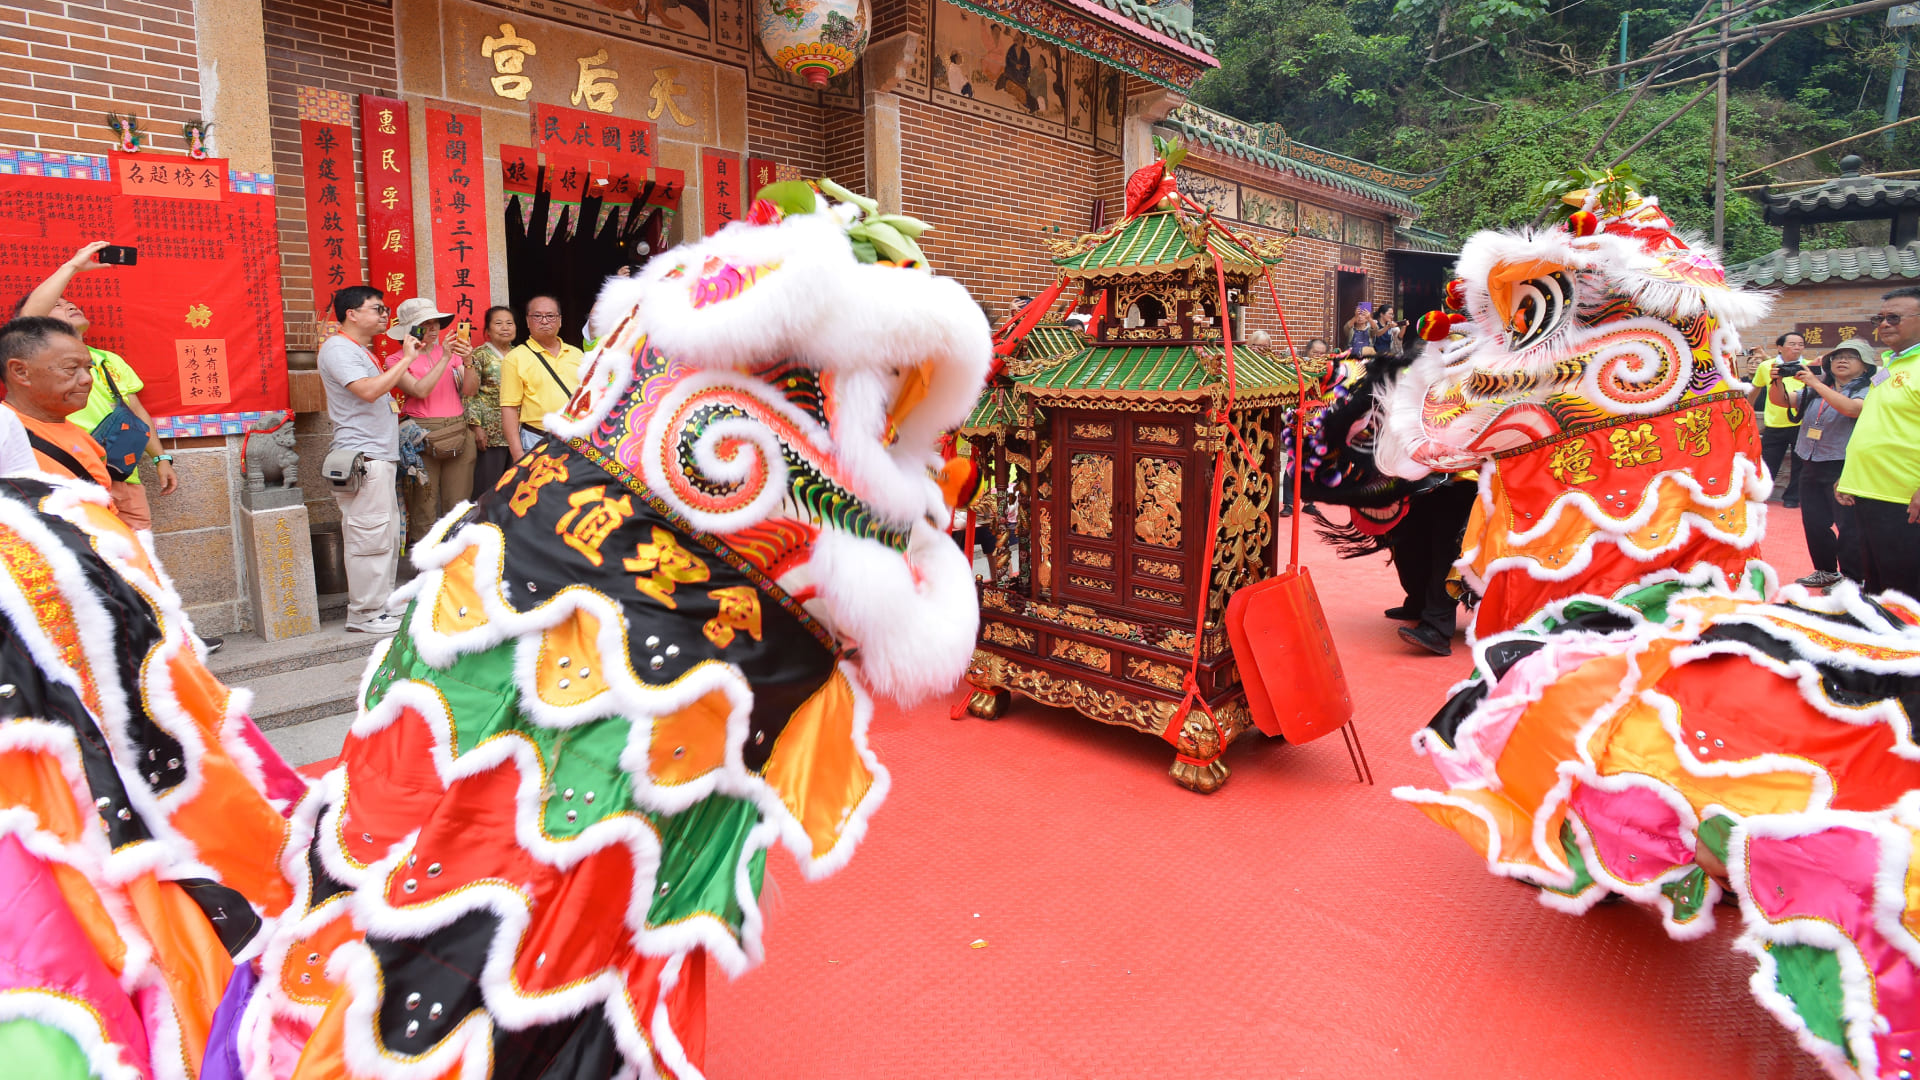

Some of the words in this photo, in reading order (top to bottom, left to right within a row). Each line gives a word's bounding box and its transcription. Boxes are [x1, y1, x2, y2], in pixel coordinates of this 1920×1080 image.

[481, 23, 697, 127] 天后宮
[545, 116, 650, 156] 護國庇民
[128, 162, 220, 188] 金榜題名
[203, 345, 222, 398] 如有錯漏
[495, 442, 763, 649] 宮值理會
